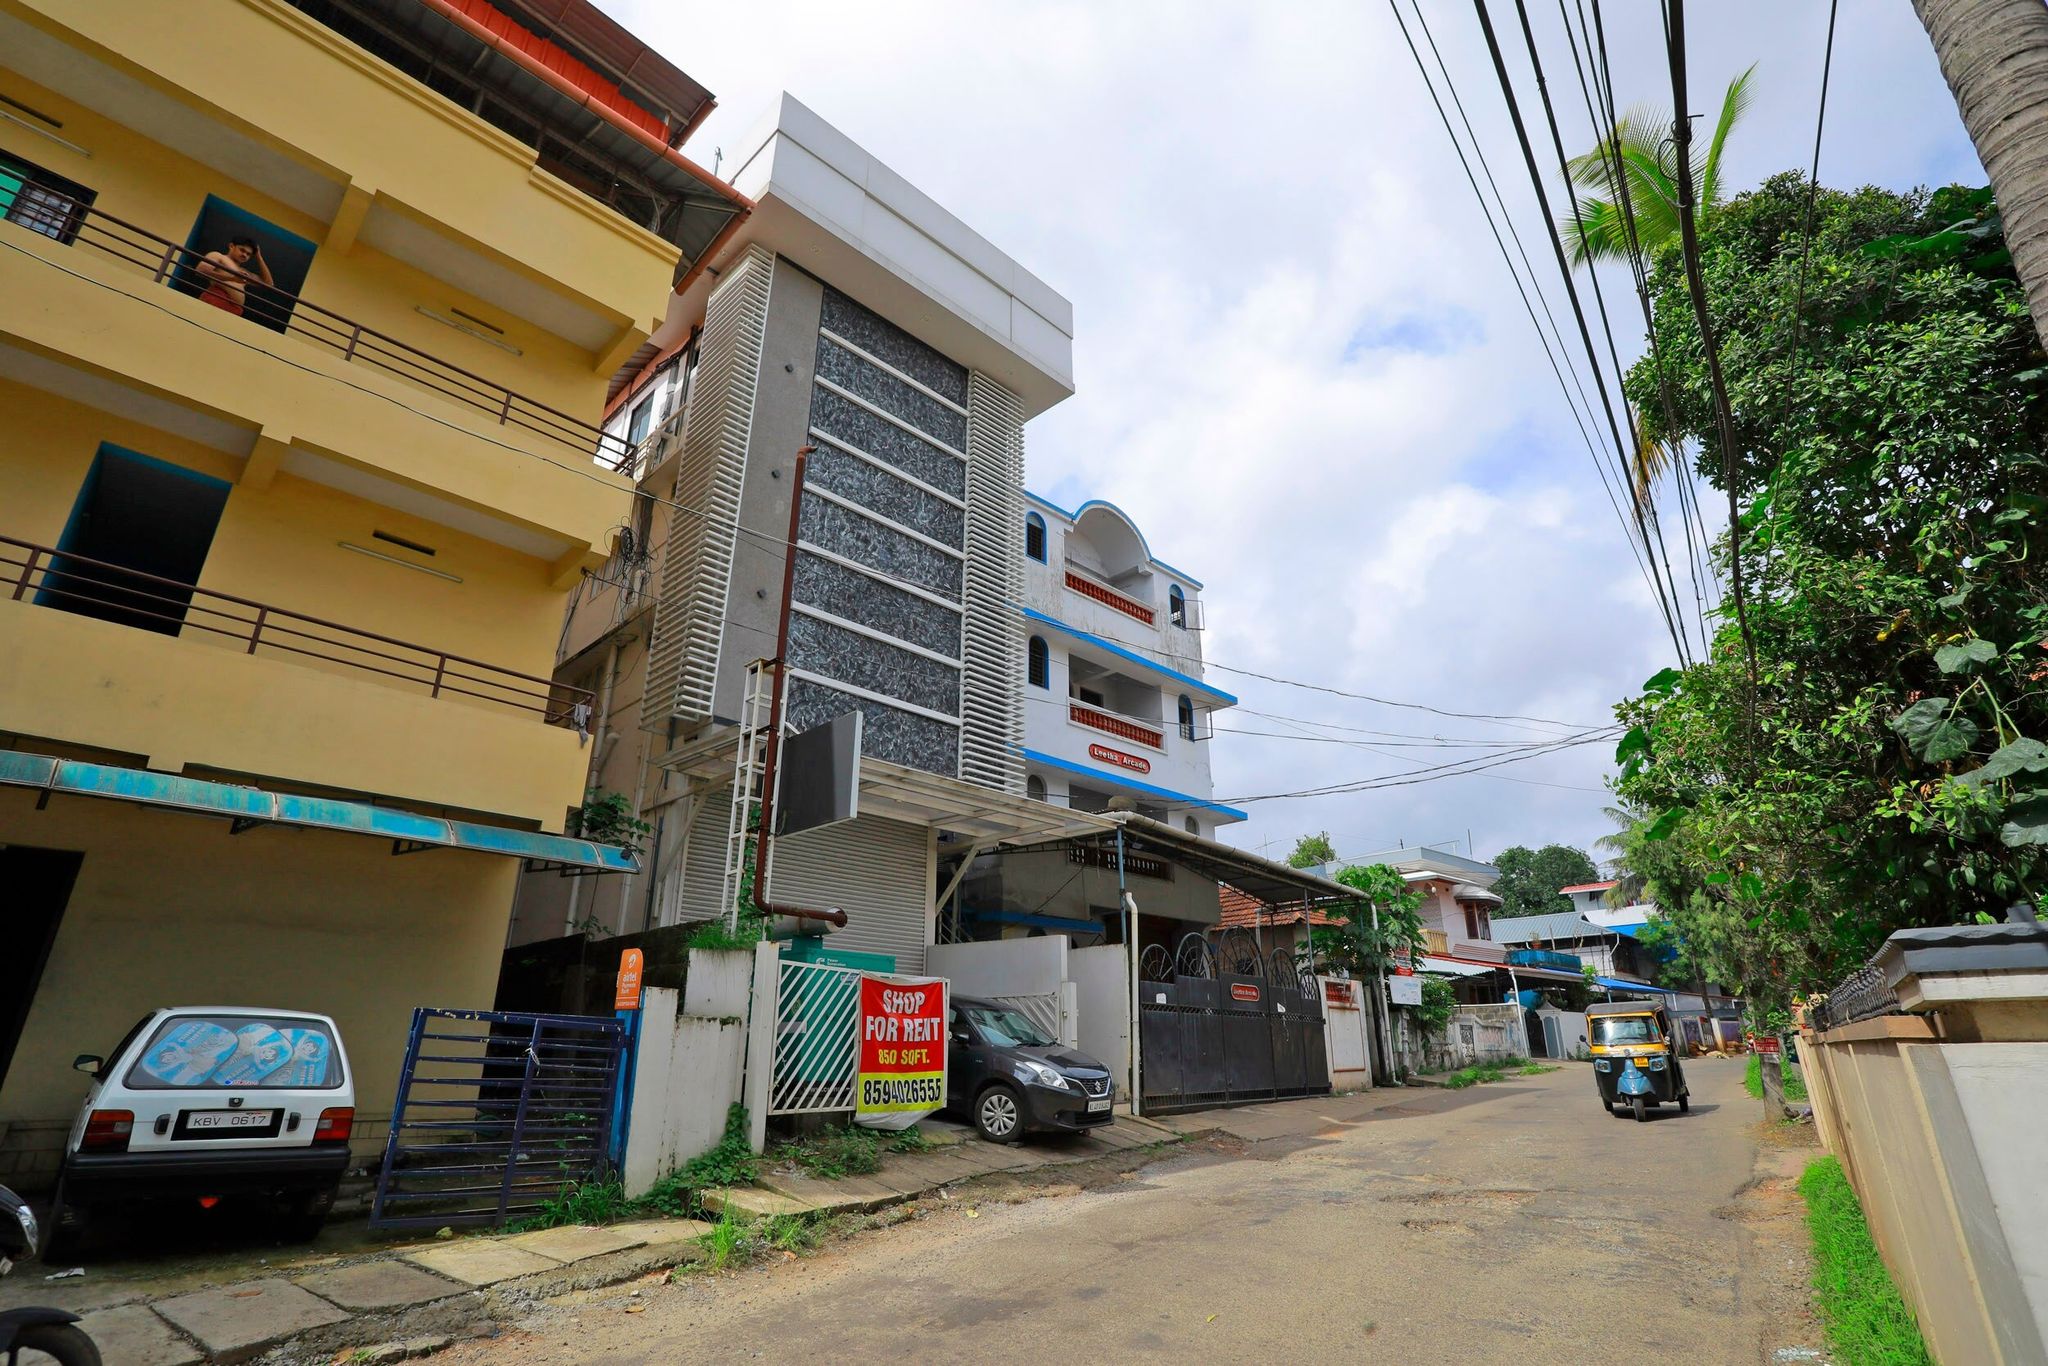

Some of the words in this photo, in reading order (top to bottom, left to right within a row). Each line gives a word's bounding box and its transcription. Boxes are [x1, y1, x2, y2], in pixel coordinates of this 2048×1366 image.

[1123, 756, 1146, 769] Arcade
[882, 989, 925, 1014] SHOP
[865, 1015, 899, 1042] FOR
[903, 1017, 940, 1042] RENT
[878, 1048, 897, 1065] 850
[900, 1048, 930, 1066] SQFT.
[863, 1078, 941, 1105] 8594026555
[193, 1117, 221, 1126] KBV
[231, 1115, 266, 1125] 0617
